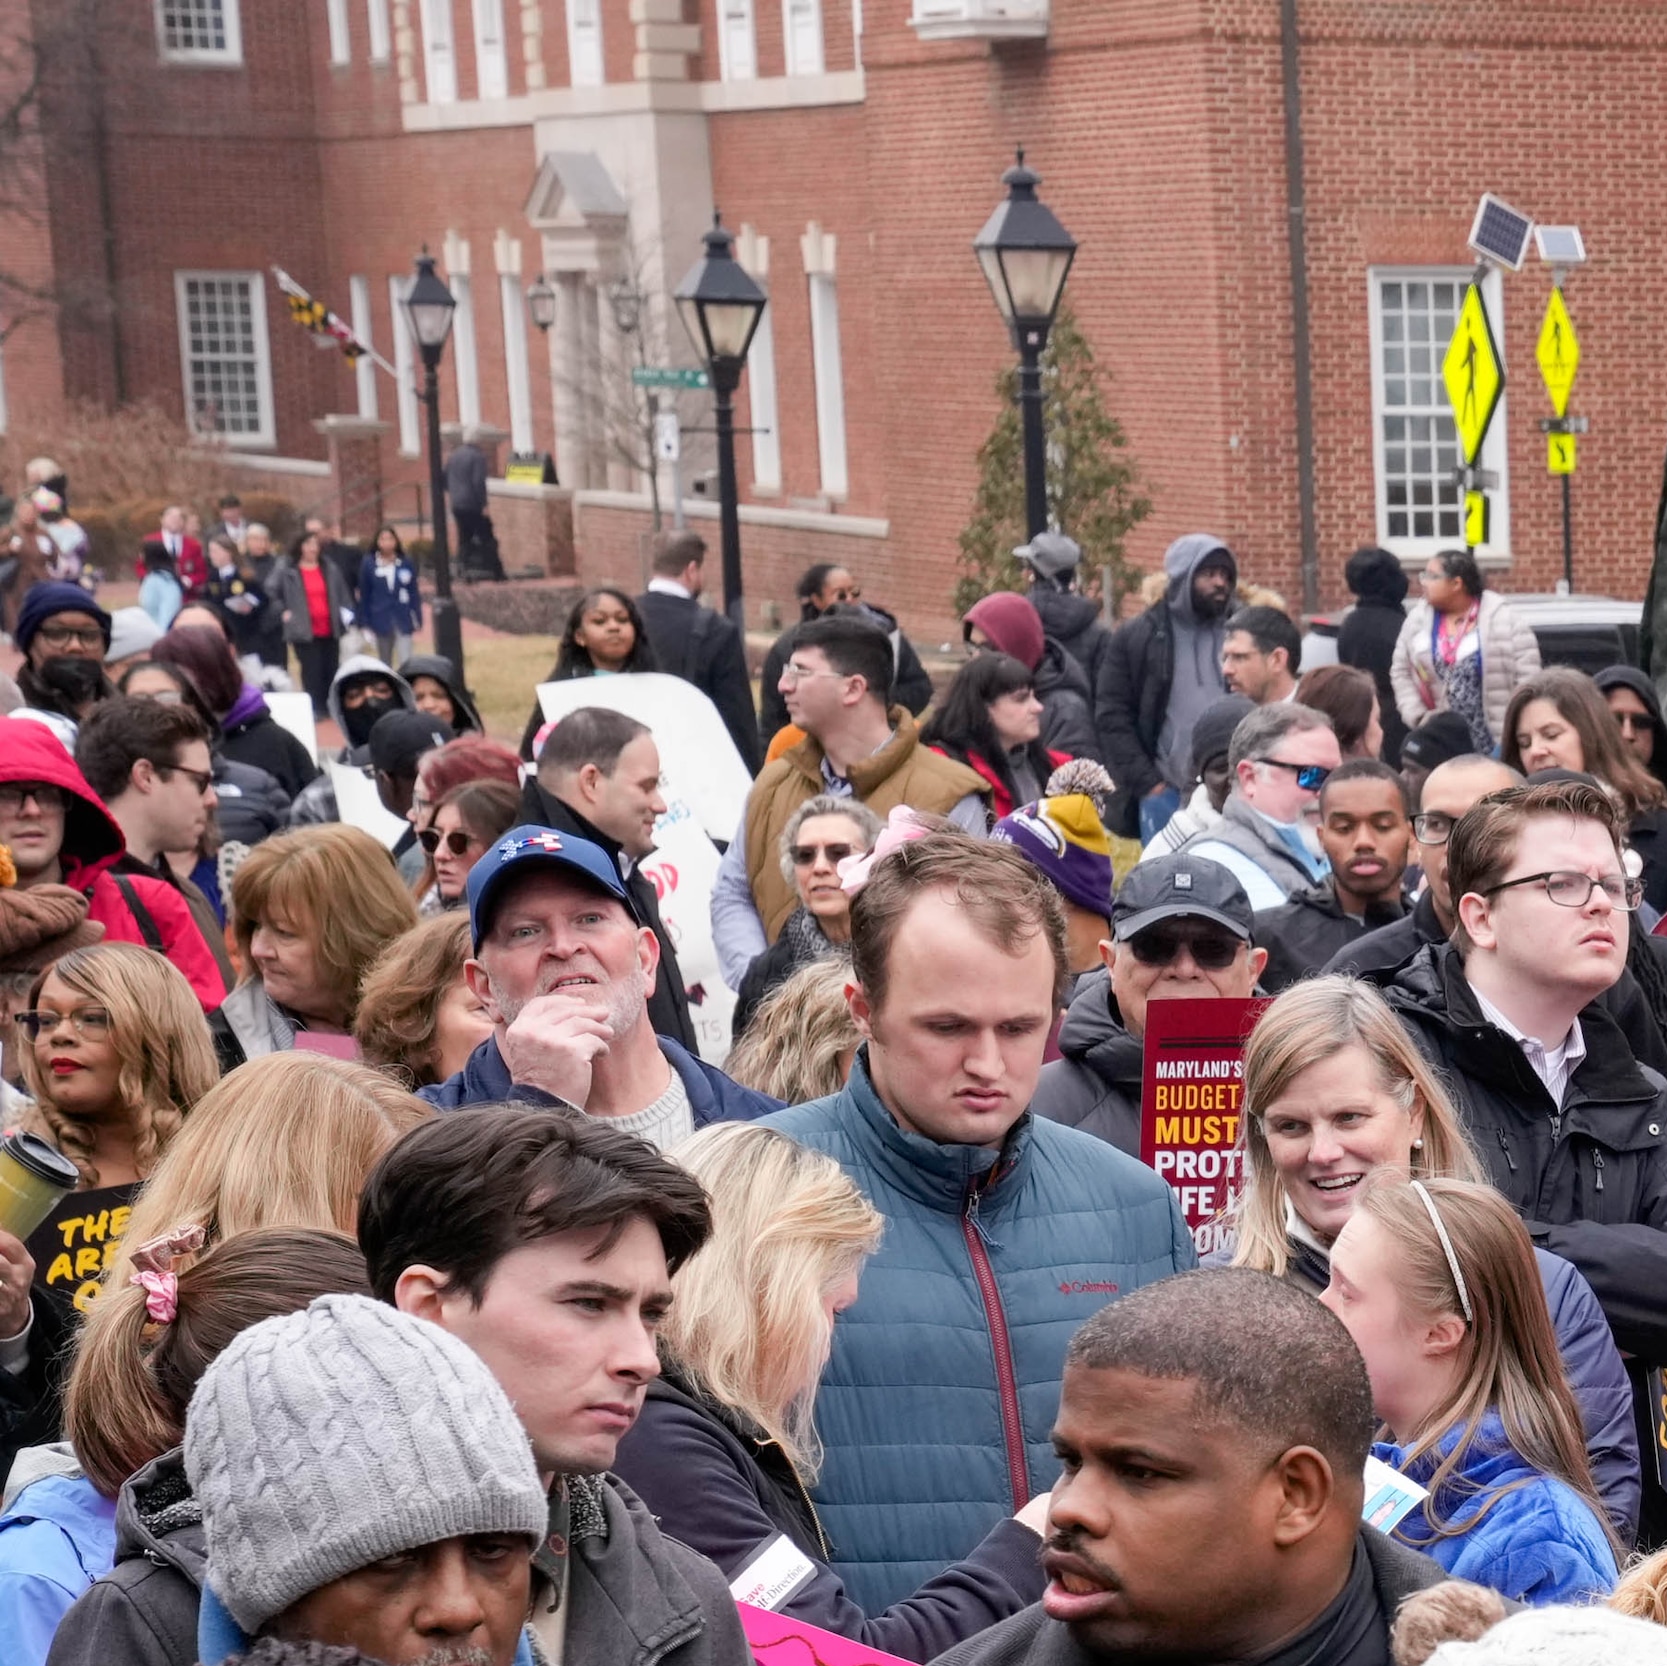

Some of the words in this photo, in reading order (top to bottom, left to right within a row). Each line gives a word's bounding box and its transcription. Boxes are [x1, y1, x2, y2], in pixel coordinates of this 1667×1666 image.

[1155, 1060, 1243, 1079] MARYLAND'S
[1155, 1083, 1240, 1111] BUDGET
[1154, 1115, 1240, 1145] MUST
[1153, 1149, 1254, 1180] PROT
[58, 1205, 131, 1248] THE
[757, 1564, 807, 1610] lf-Direction.
